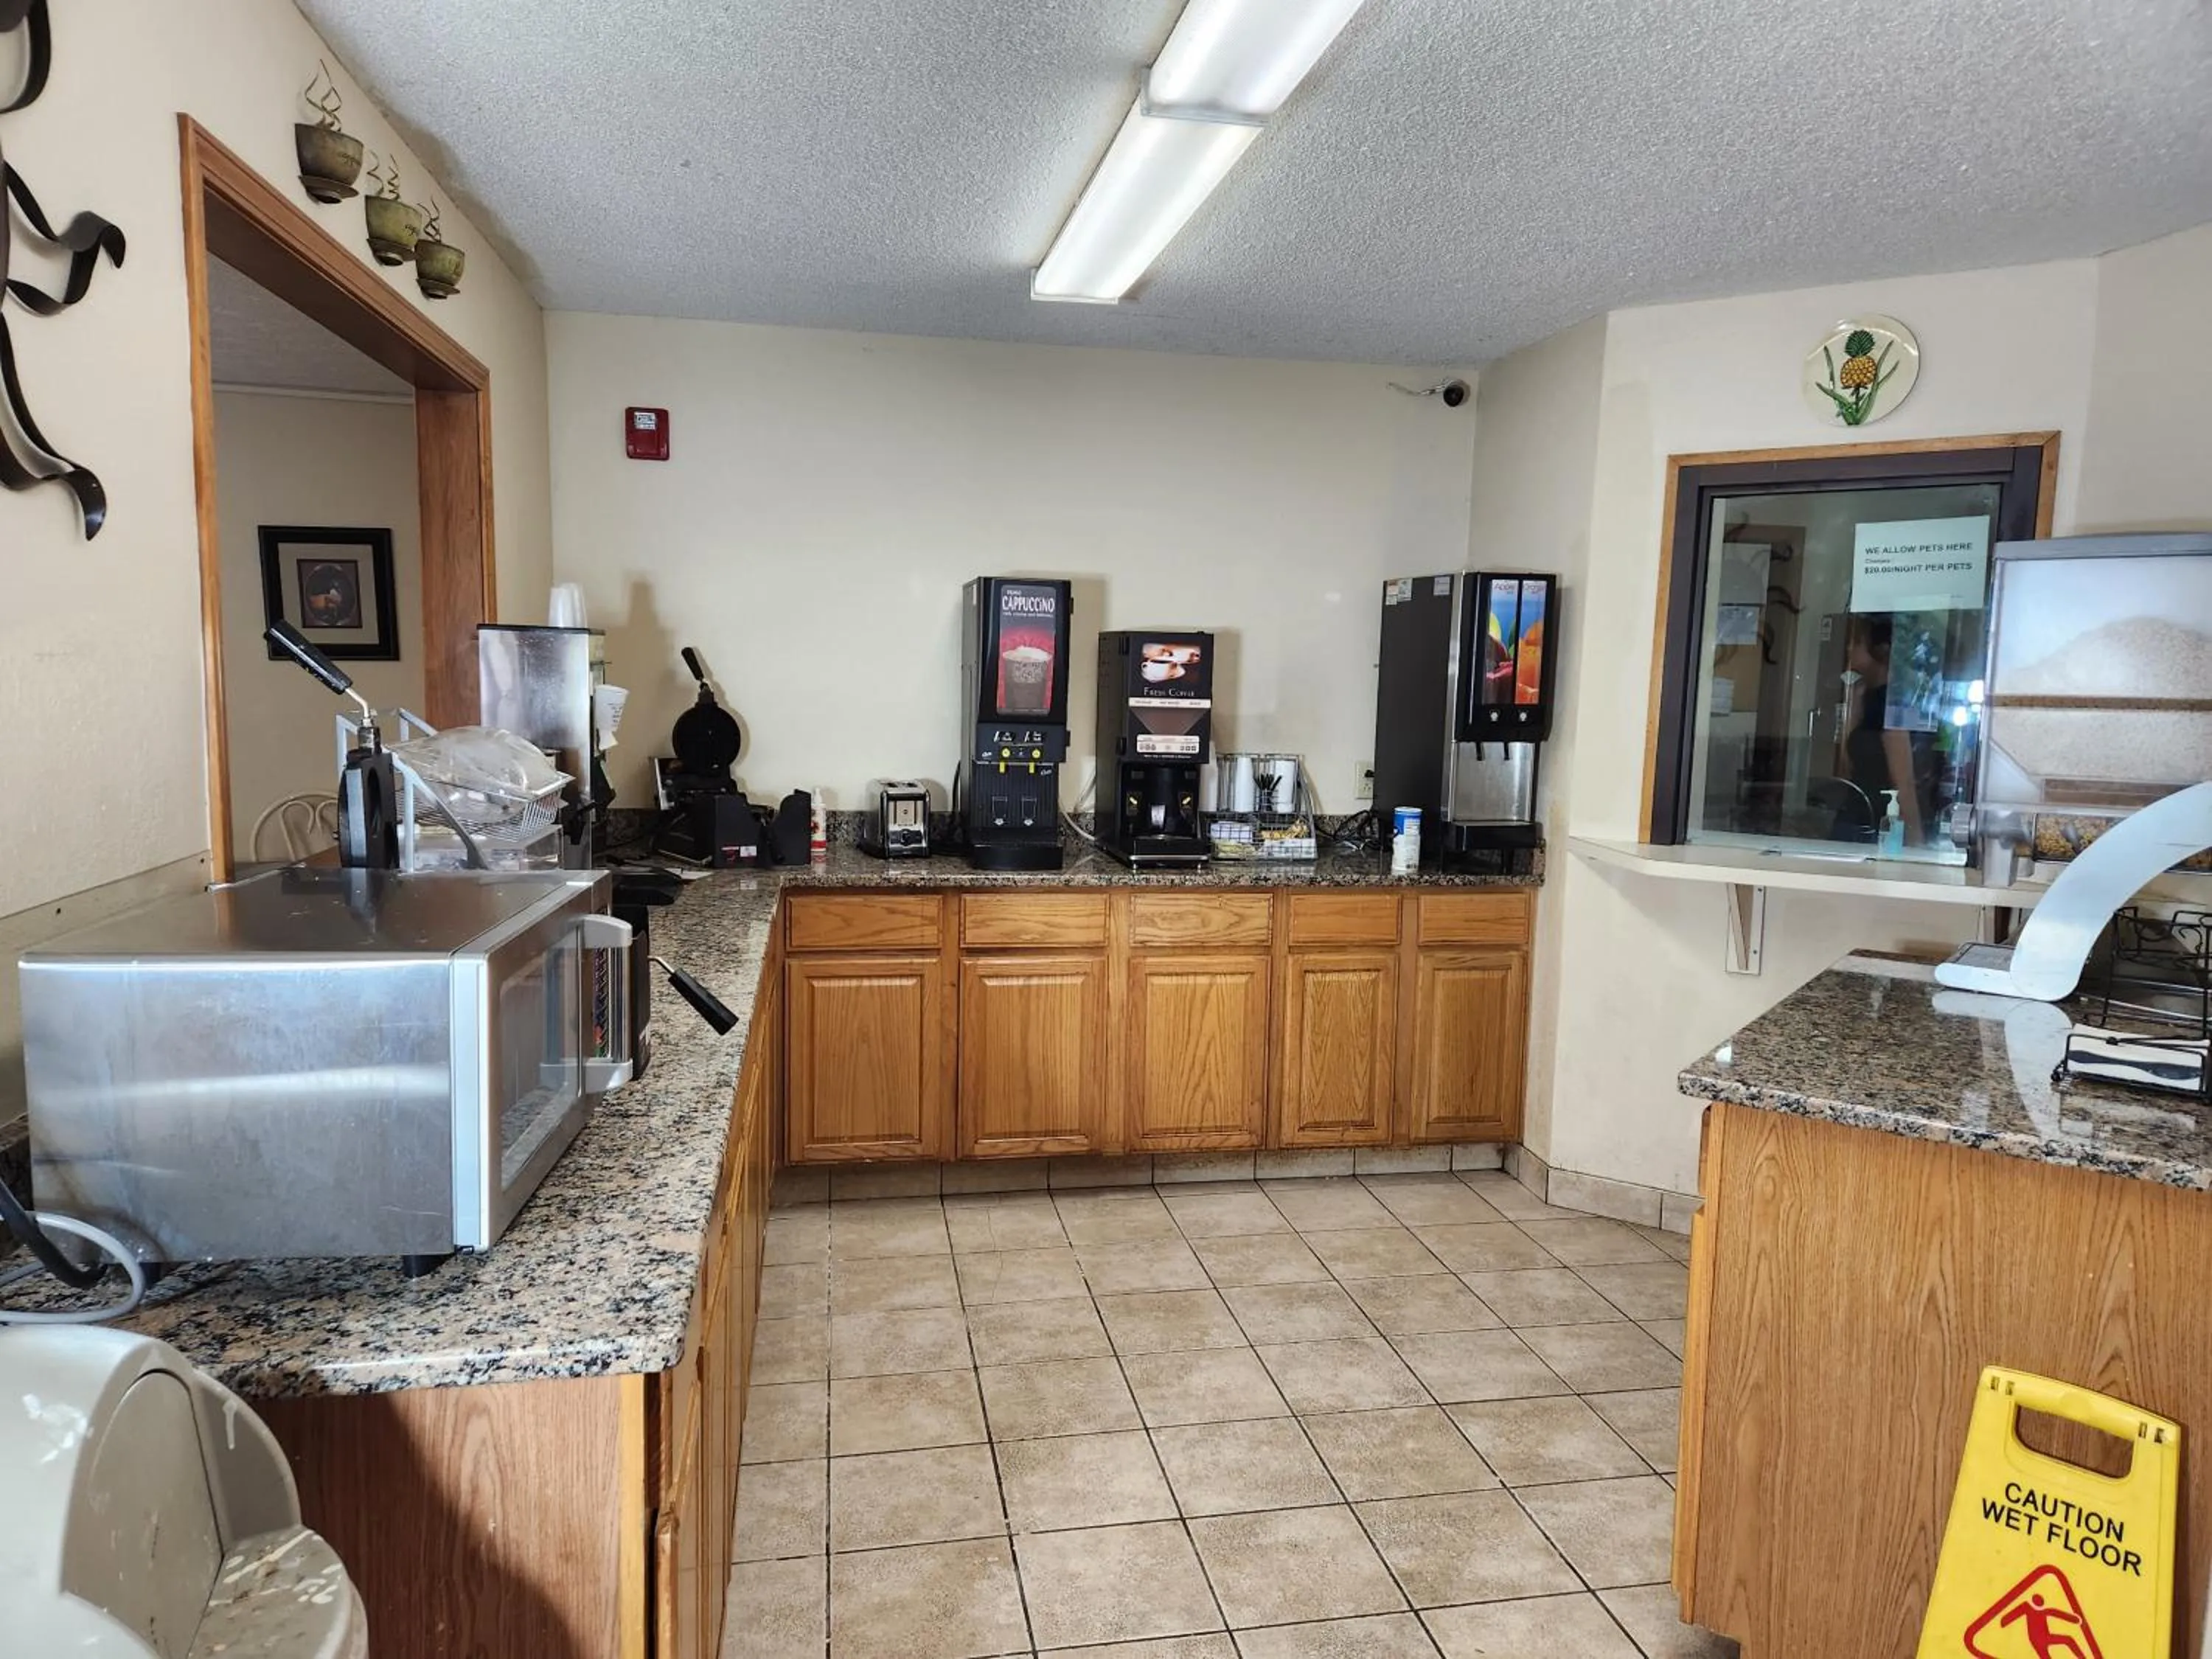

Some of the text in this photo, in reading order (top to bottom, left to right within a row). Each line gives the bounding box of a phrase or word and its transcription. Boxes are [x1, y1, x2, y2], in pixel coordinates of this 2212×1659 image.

[1865, 542, 1973, 554] WE ALLOW PETS HERE
[1947, 562, 1973, 571] PETS
[2004, 1482, 2125, 1543] CAUTION
[1981, 1498, 2142, 1576] WET FLOOR
